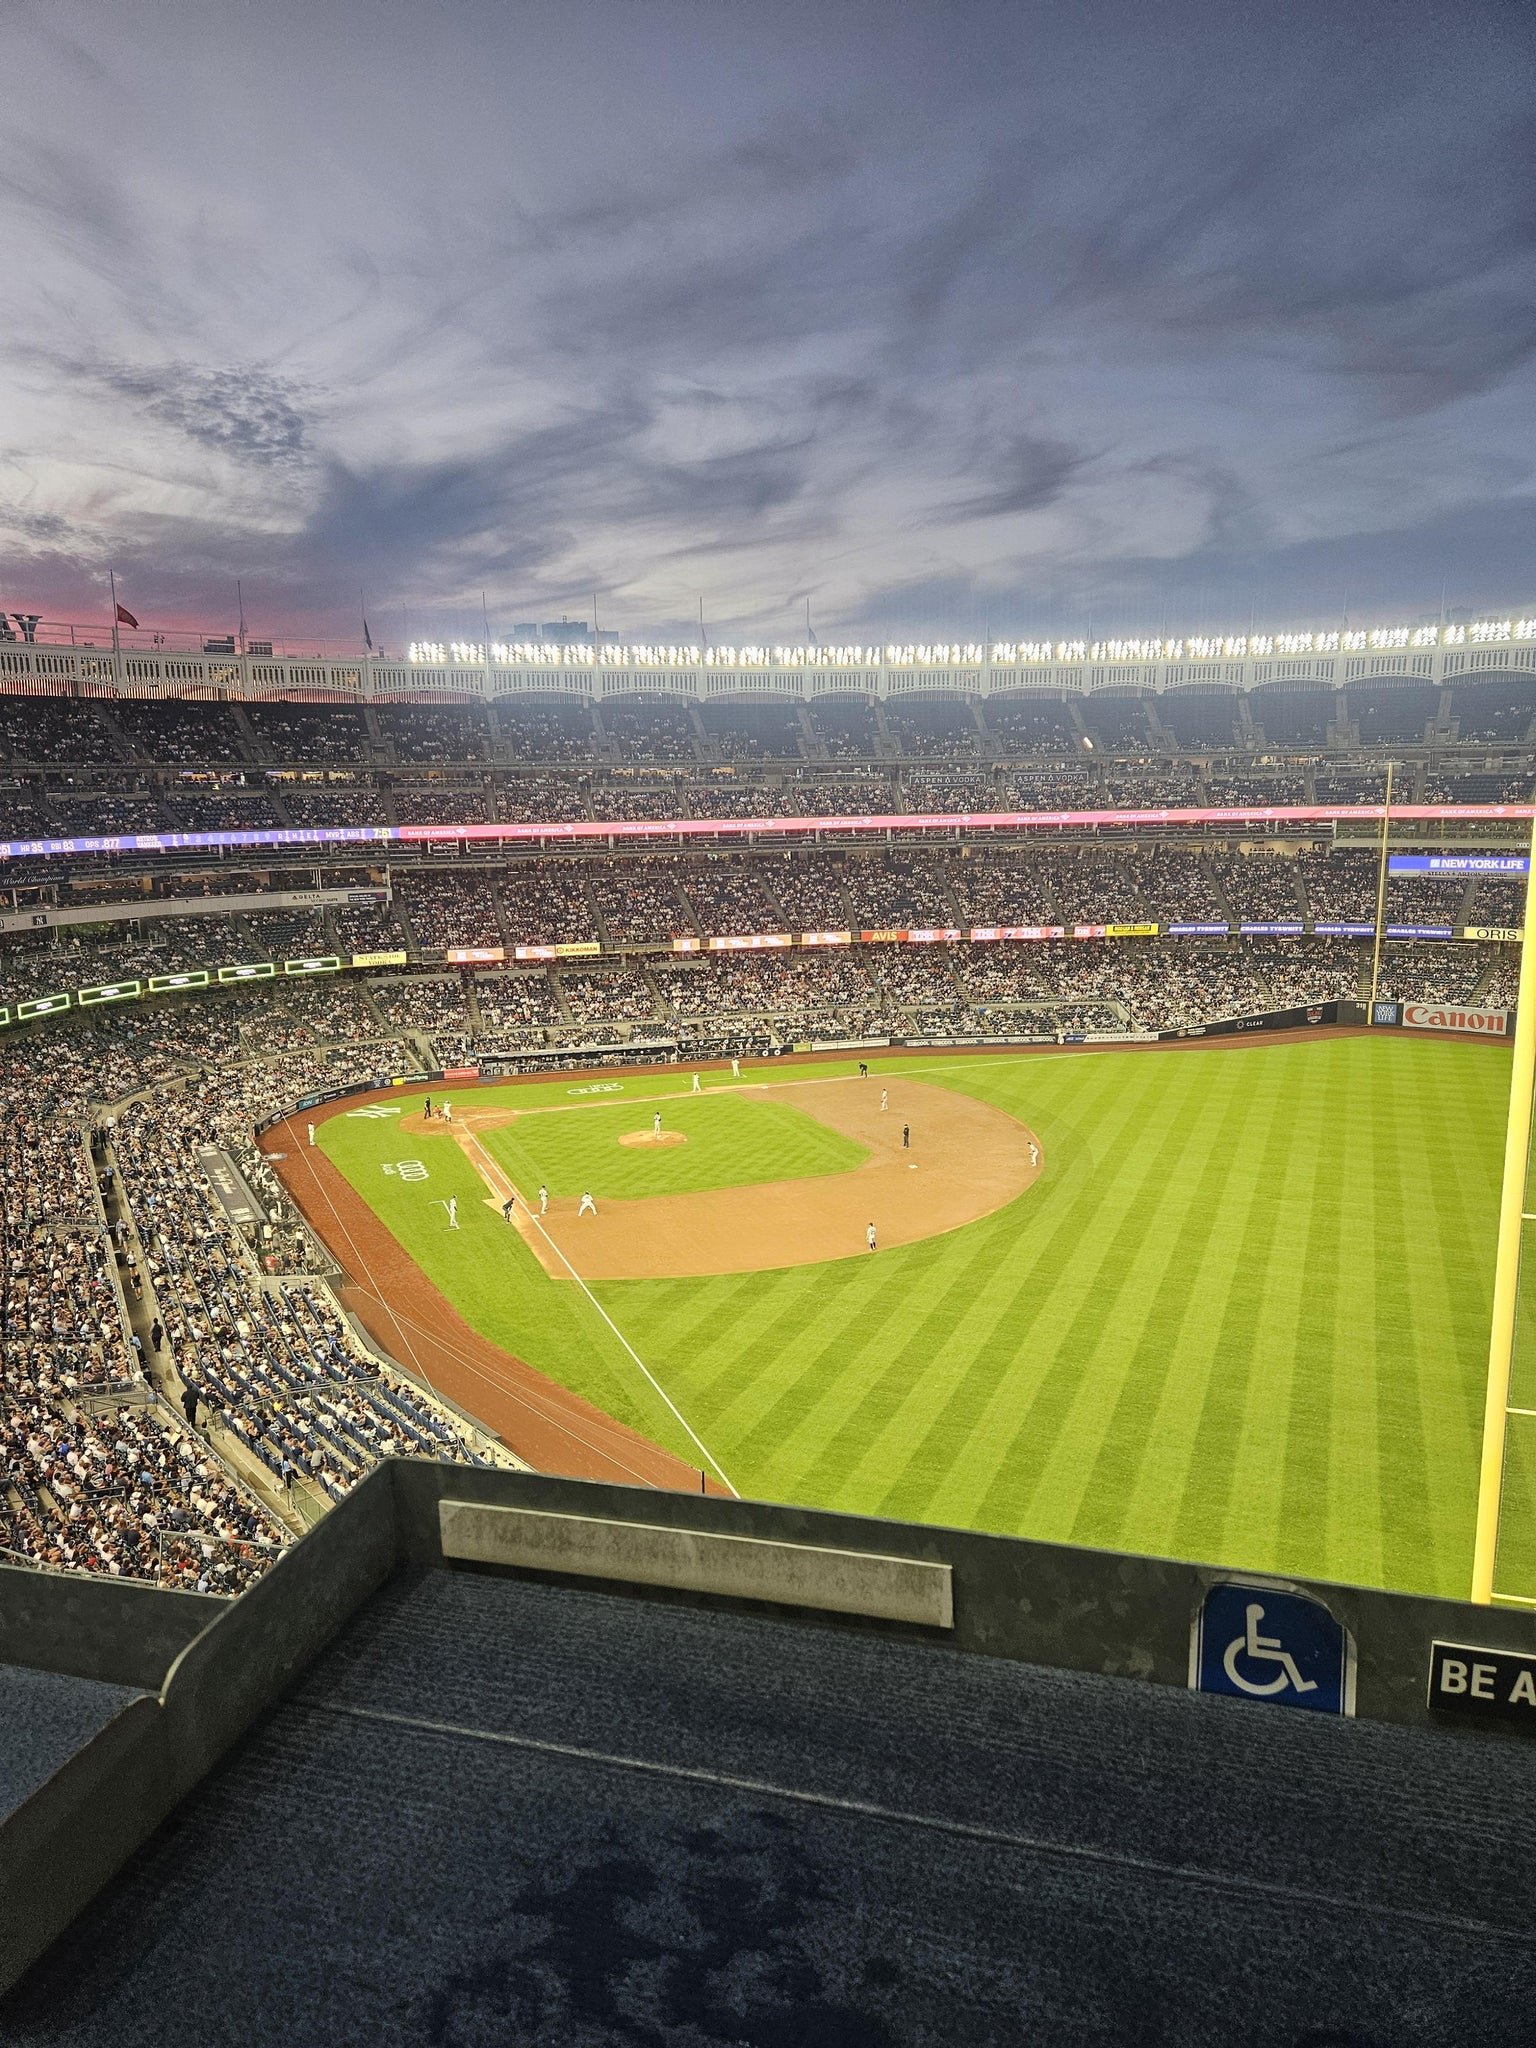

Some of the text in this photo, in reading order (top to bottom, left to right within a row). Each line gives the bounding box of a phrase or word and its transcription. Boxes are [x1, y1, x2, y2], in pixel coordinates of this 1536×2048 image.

[952, 776, 981, 784] VODKA
[1017, 774, 1084, 783] ASPEN VODKA
[31, 843, 43, 852] 35
[51, 843, 61, 851] RBI
[63, 841, 74, 850] 83
[85, 840, 99, 848] OPS
[101, 838, 120, 848] .877
[1441, 859, 1524, 870] NEW YORK LIFE
[3, 874, 65, 885] World Champions
[872, 931, 898, 941] AVIS
[1477, 929, 1517, 940] ORIS
[1405, 1006, 1503, 1031] Canon
[1440, 1658, 1498, 1700] BE
